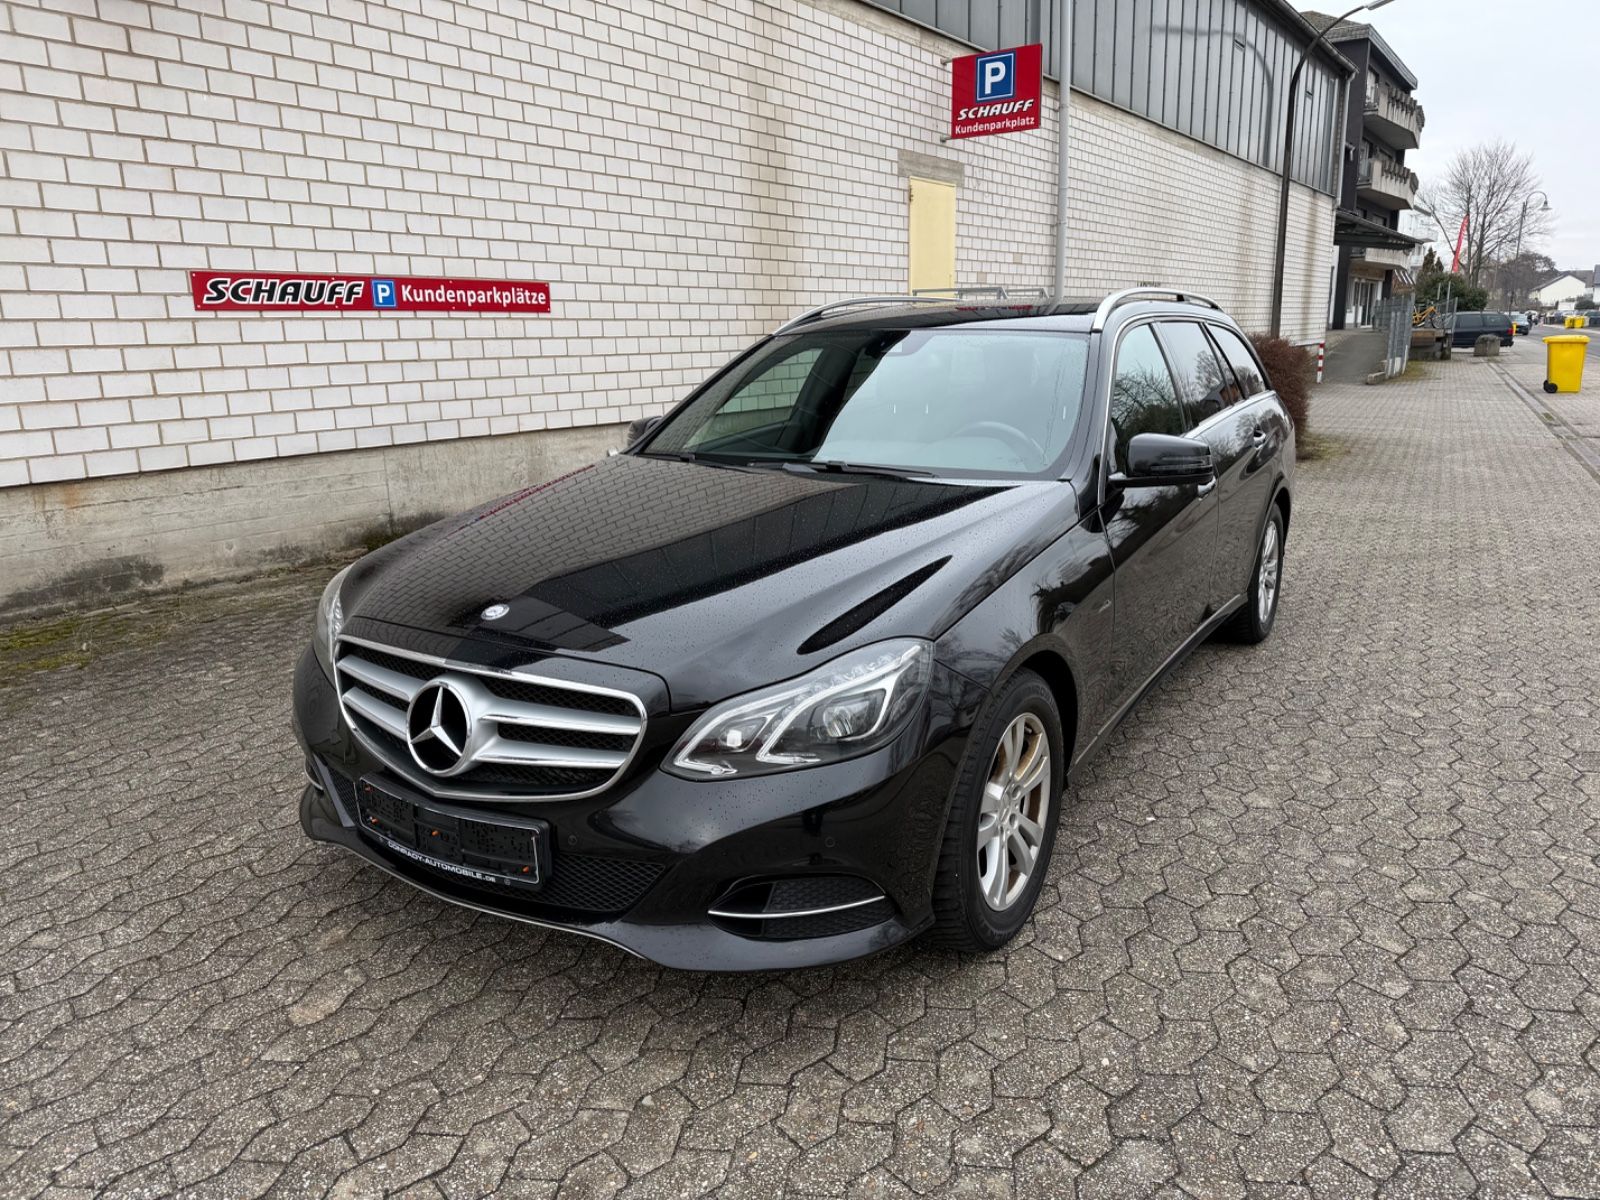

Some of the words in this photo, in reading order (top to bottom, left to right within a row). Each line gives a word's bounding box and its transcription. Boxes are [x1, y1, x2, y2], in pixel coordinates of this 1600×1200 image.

[985, 61, 1006, 95] P
[957, 99, 1034, 121] SCHAUFF
[955, 116, 1035, 135] Kundenparkplatz
[203, 277, 364, 305] SCHAUFF
[377, 284, 391, 303] P
[401, 284, 546, 307] Kundenparkplätze
